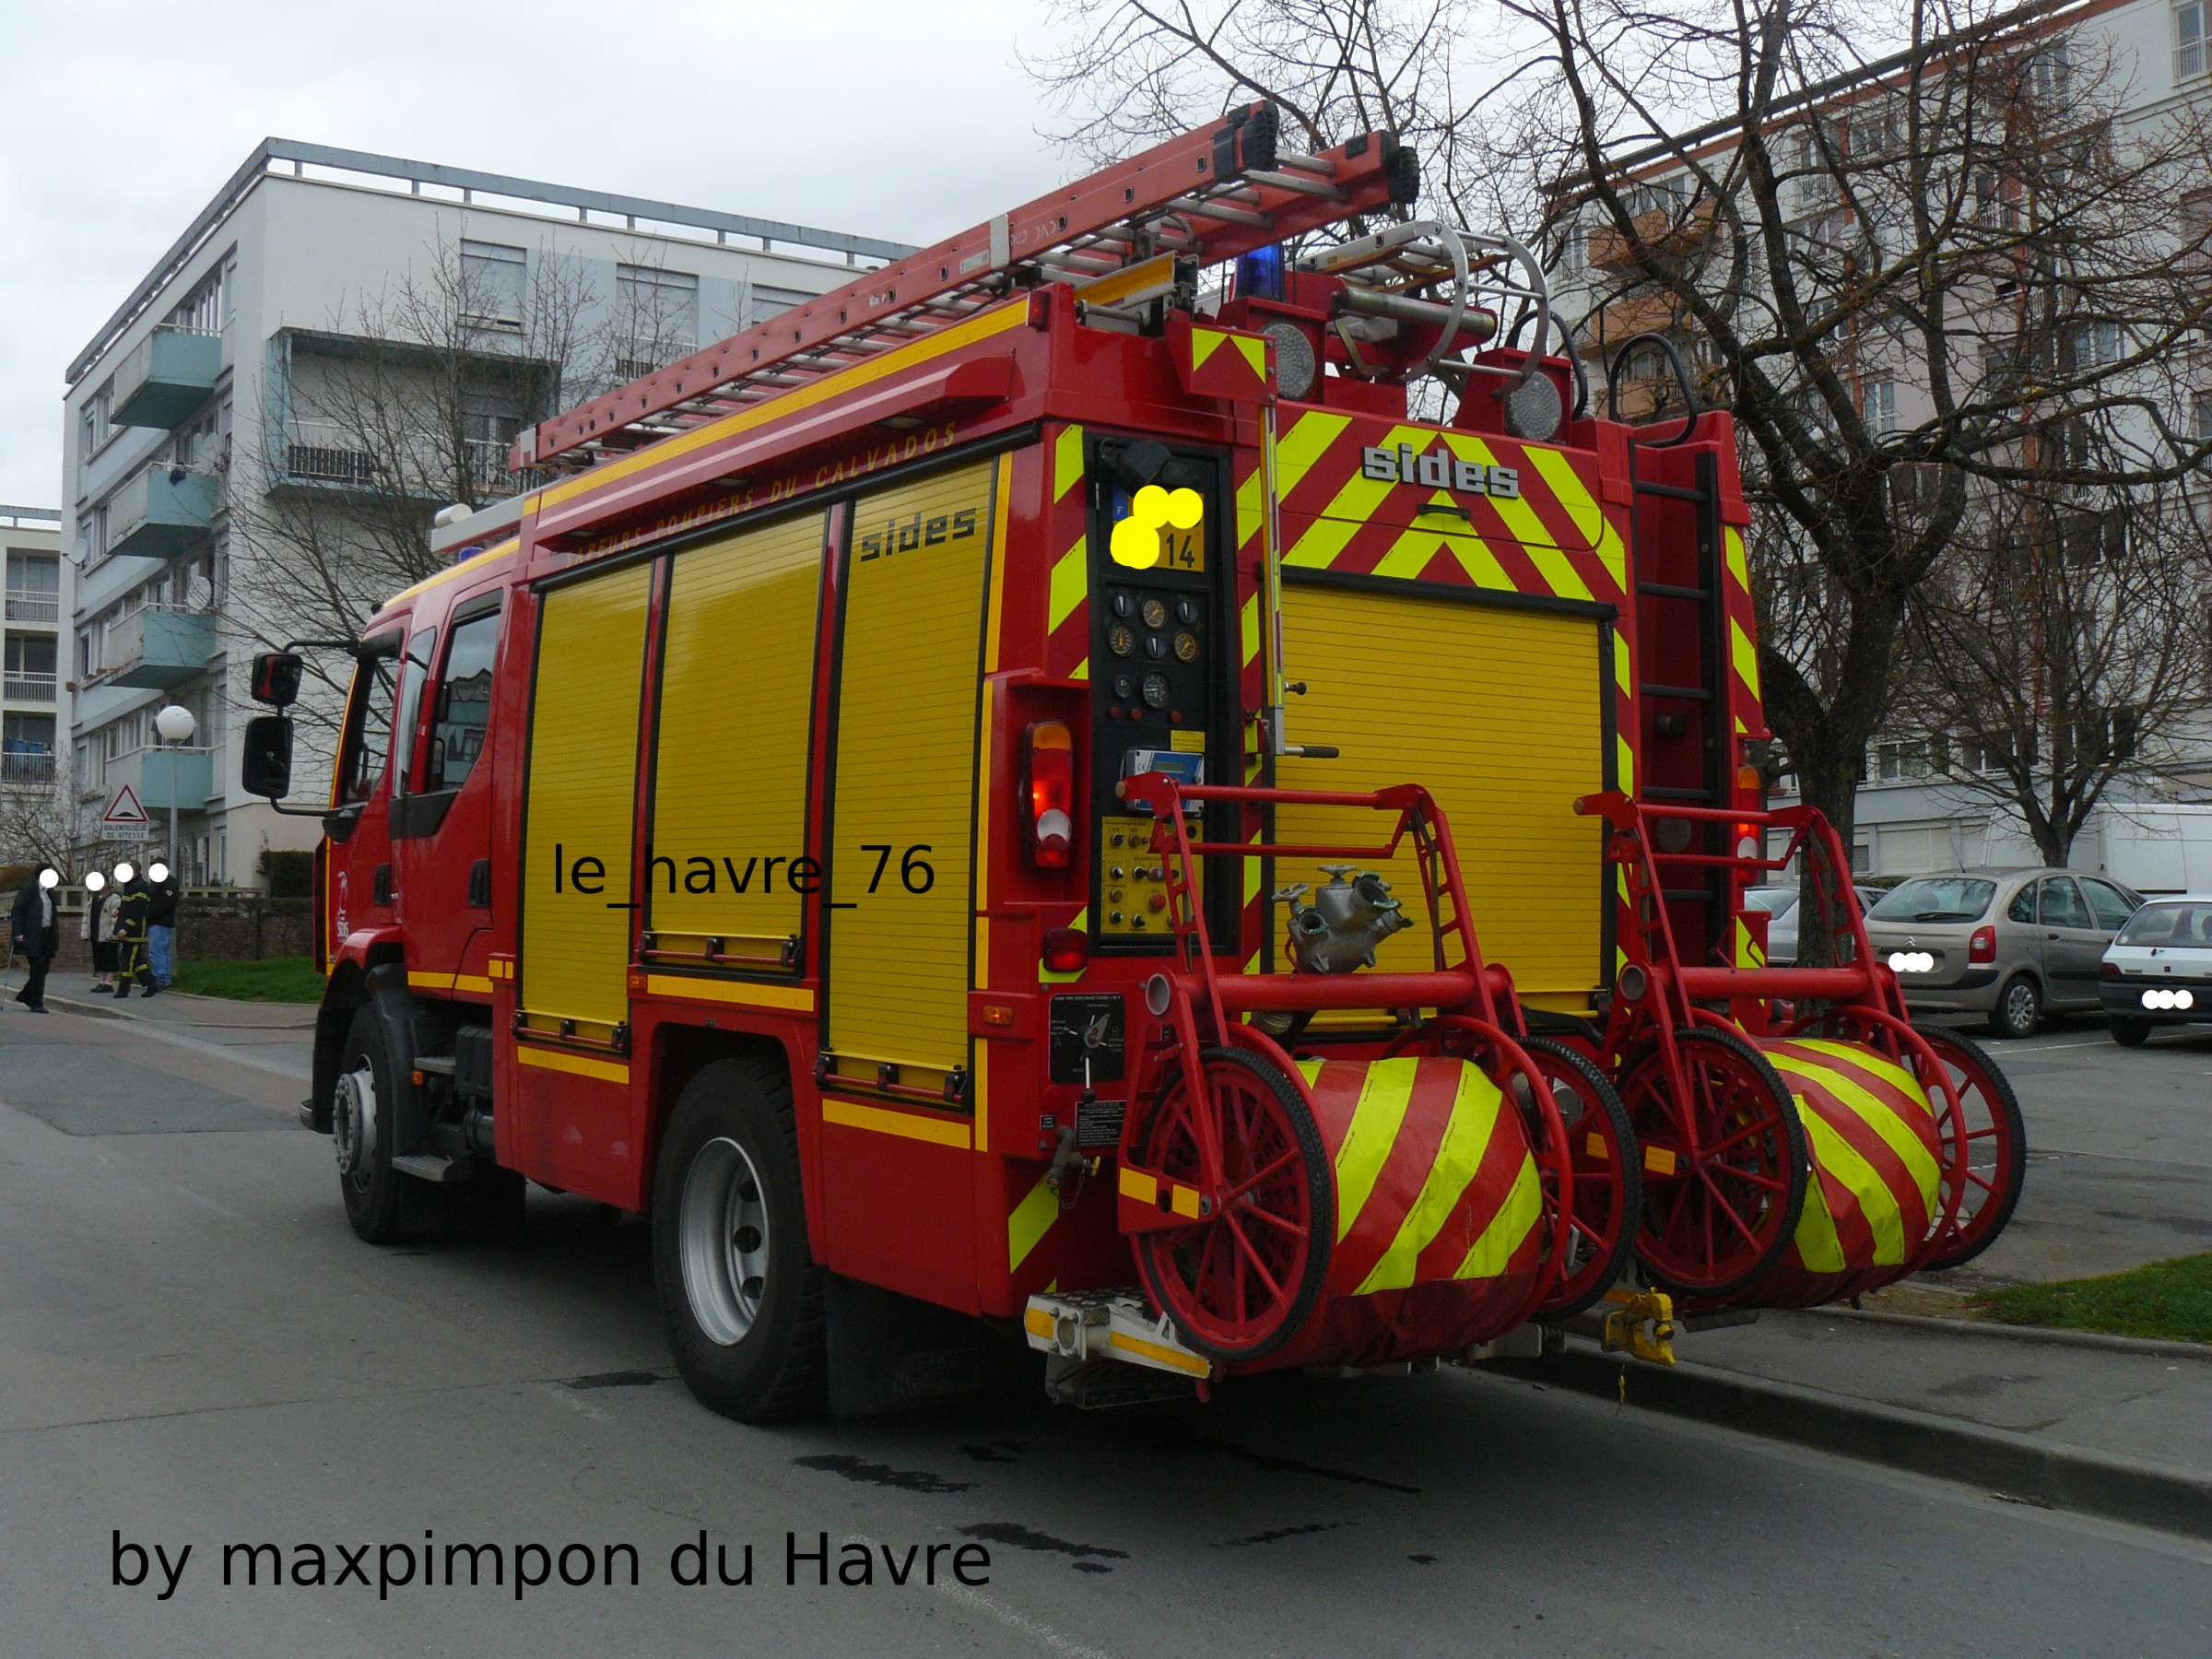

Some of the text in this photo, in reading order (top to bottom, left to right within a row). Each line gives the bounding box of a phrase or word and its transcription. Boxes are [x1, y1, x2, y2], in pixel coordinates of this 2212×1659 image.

[565, 420, 956, 569] SAPEURS POMPIERS DU CALVADOS
[1362, 442, 1519, 499] sides
[860, 508, 977, 562] sides
[1165, 532, 1195, 569] 14
